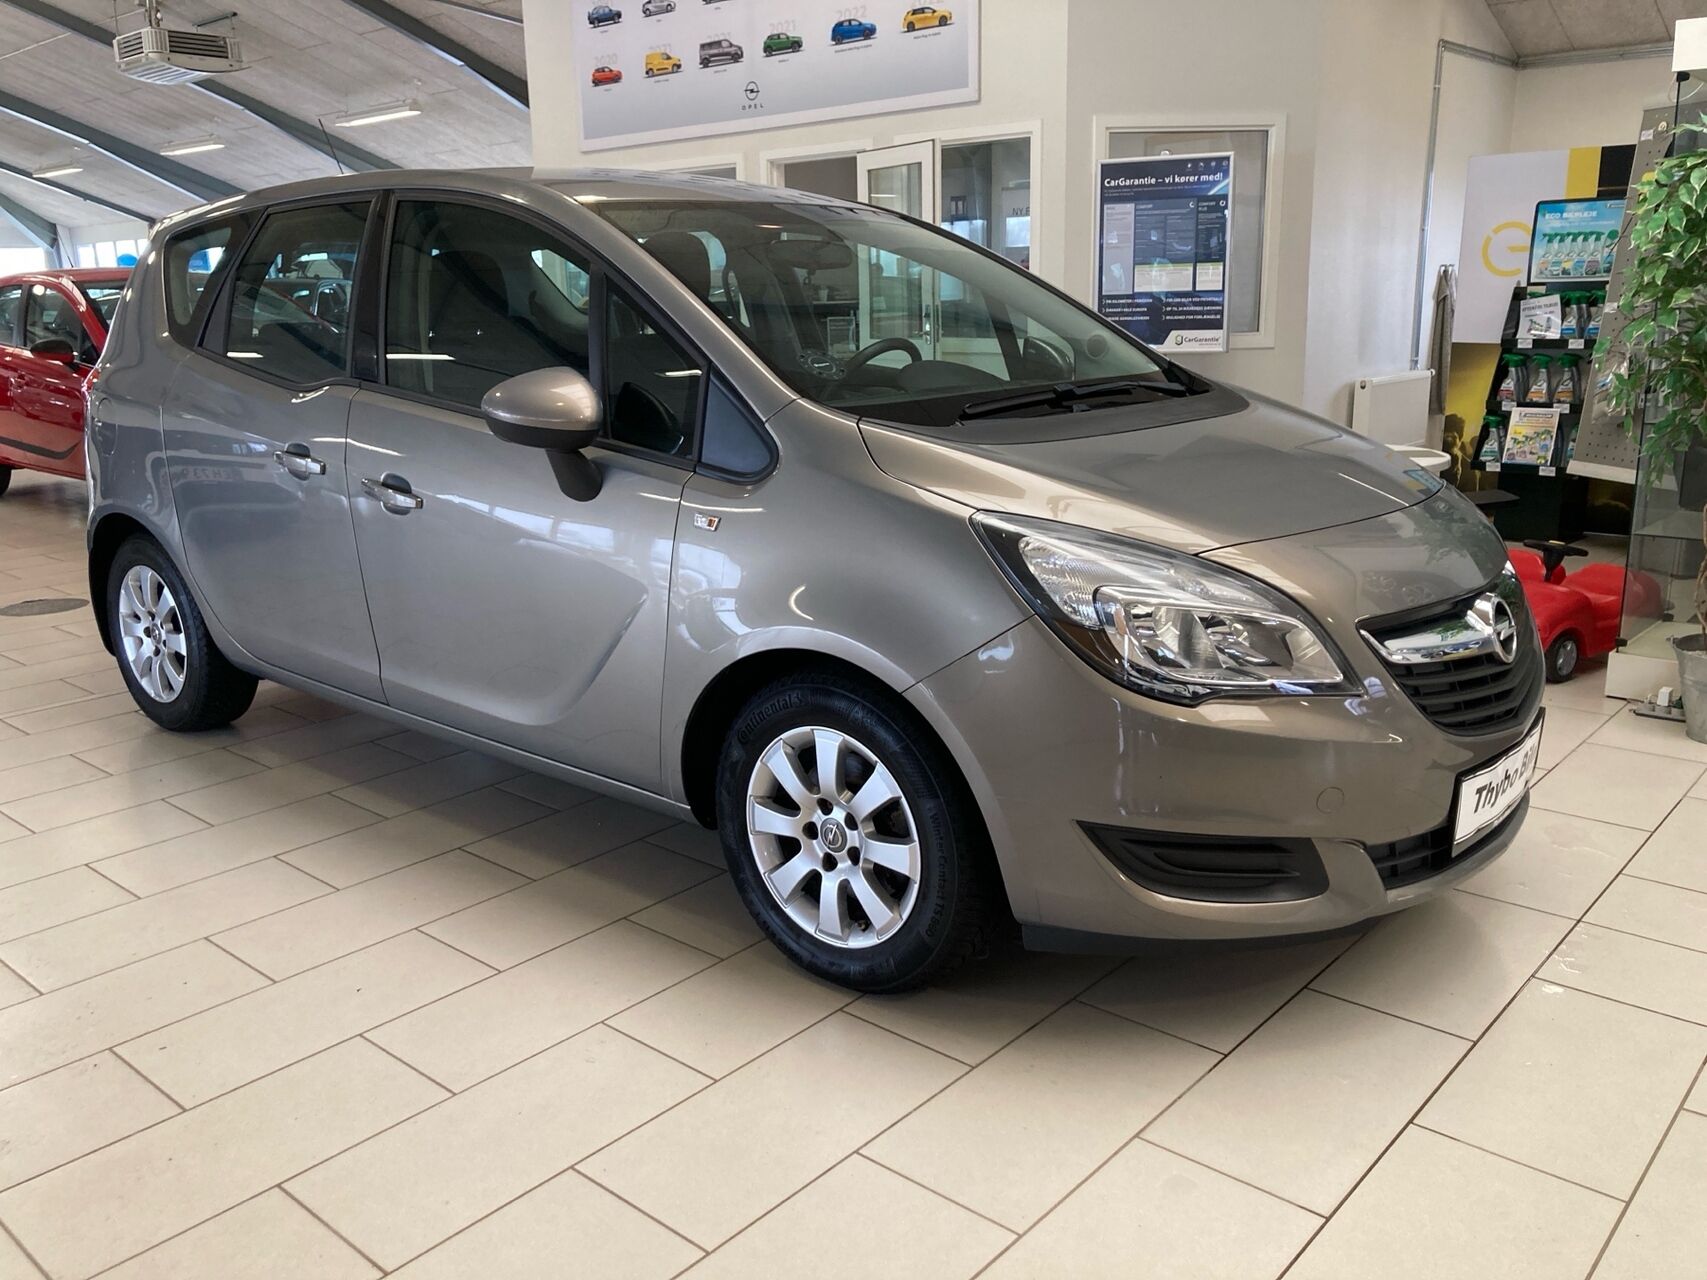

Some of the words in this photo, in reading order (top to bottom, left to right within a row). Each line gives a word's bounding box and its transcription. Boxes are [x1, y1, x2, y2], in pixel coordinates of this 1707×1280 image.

[741, 103, 764, 111] OPEL
[1104, 177, 1156, 187] CarGarantie
[1165, 174, 1173, 183] vi
[1175, 174, 1199, 183] kører
[1200, 172, 1223, 181] med!
[737, 693, 793, 744] Continental
[1473, 766, 1519, 814] Thybo
